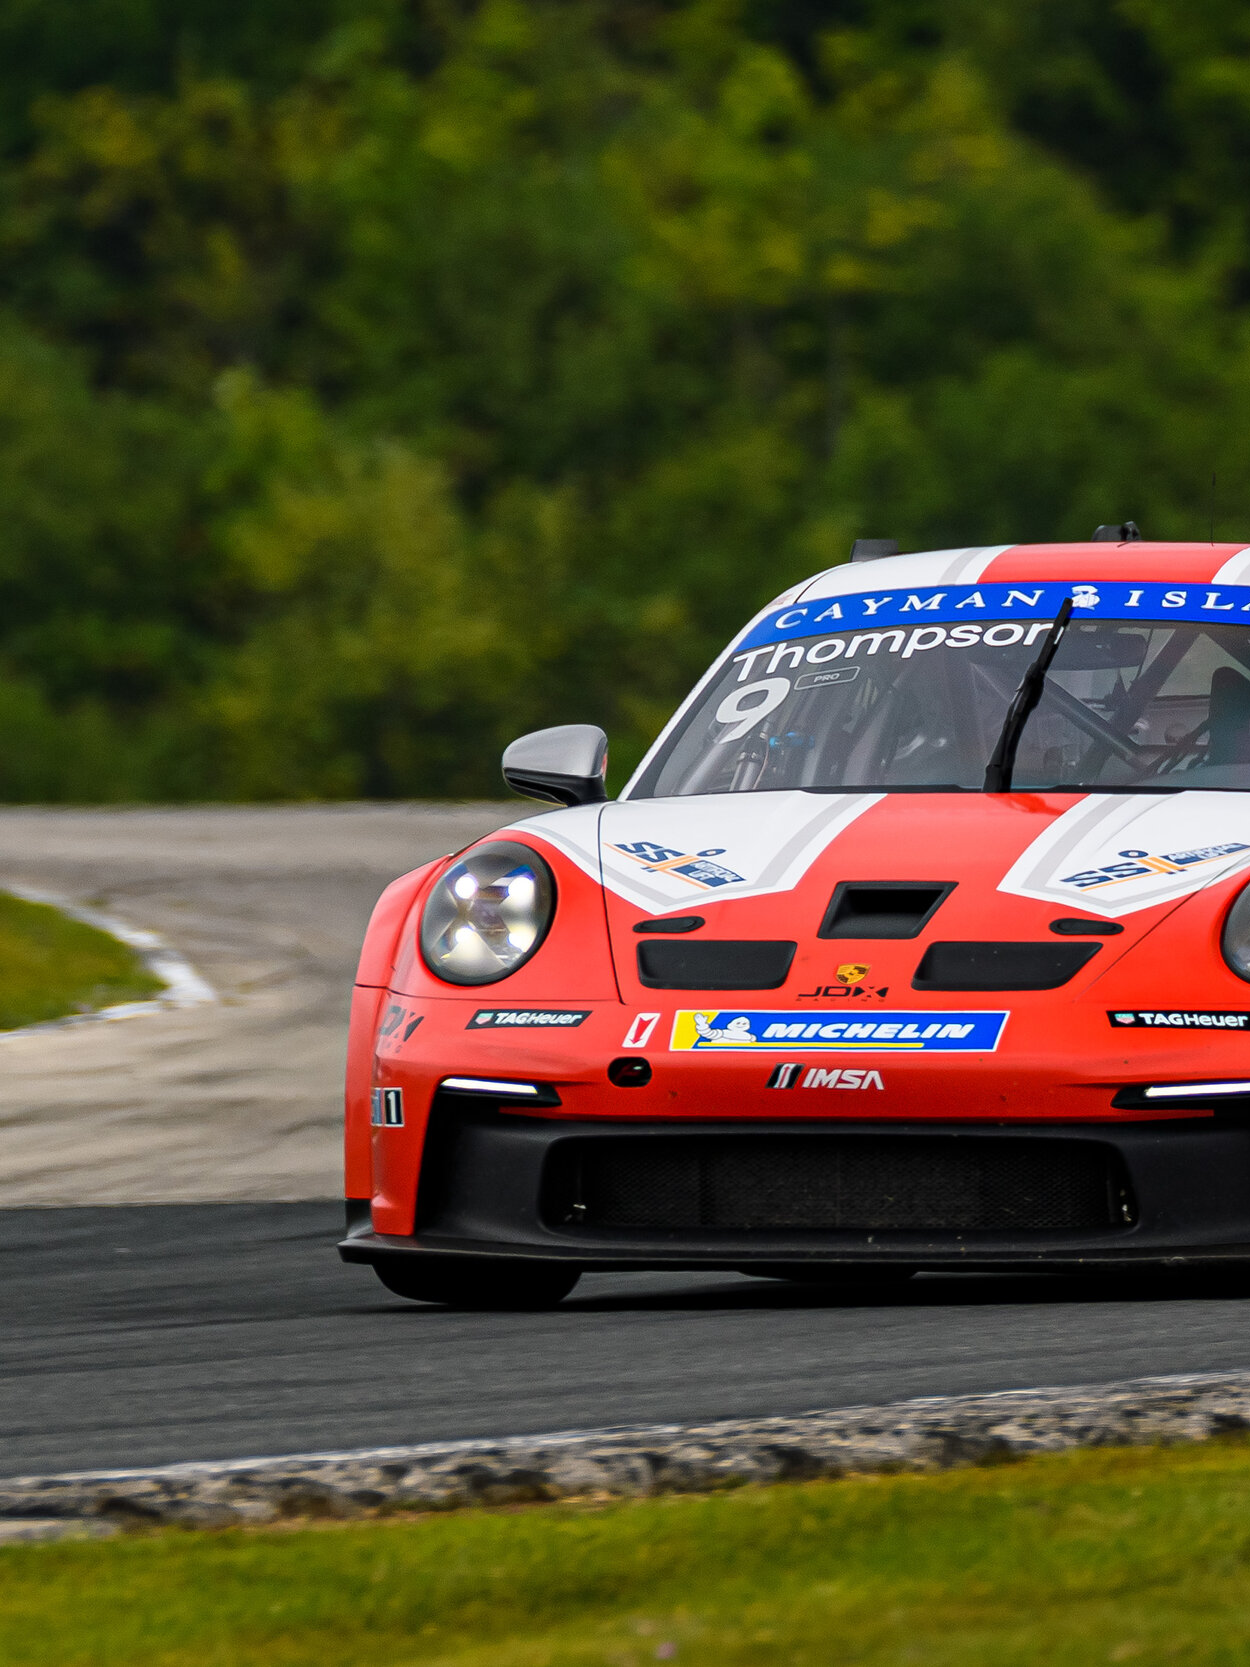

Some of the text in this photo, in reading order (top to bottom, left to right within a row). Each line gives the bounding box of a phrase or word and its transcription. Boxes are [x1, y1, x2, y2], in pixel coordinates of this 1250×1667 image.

[774, 589, 1044, 630] CAYMAN
[813, 672, 840, 684] PRO
[714, 677, 791, 745] 9
[762, 1023, 975, 1039] MICHELIN
[801, 1068, 885, 1090] IMSA
